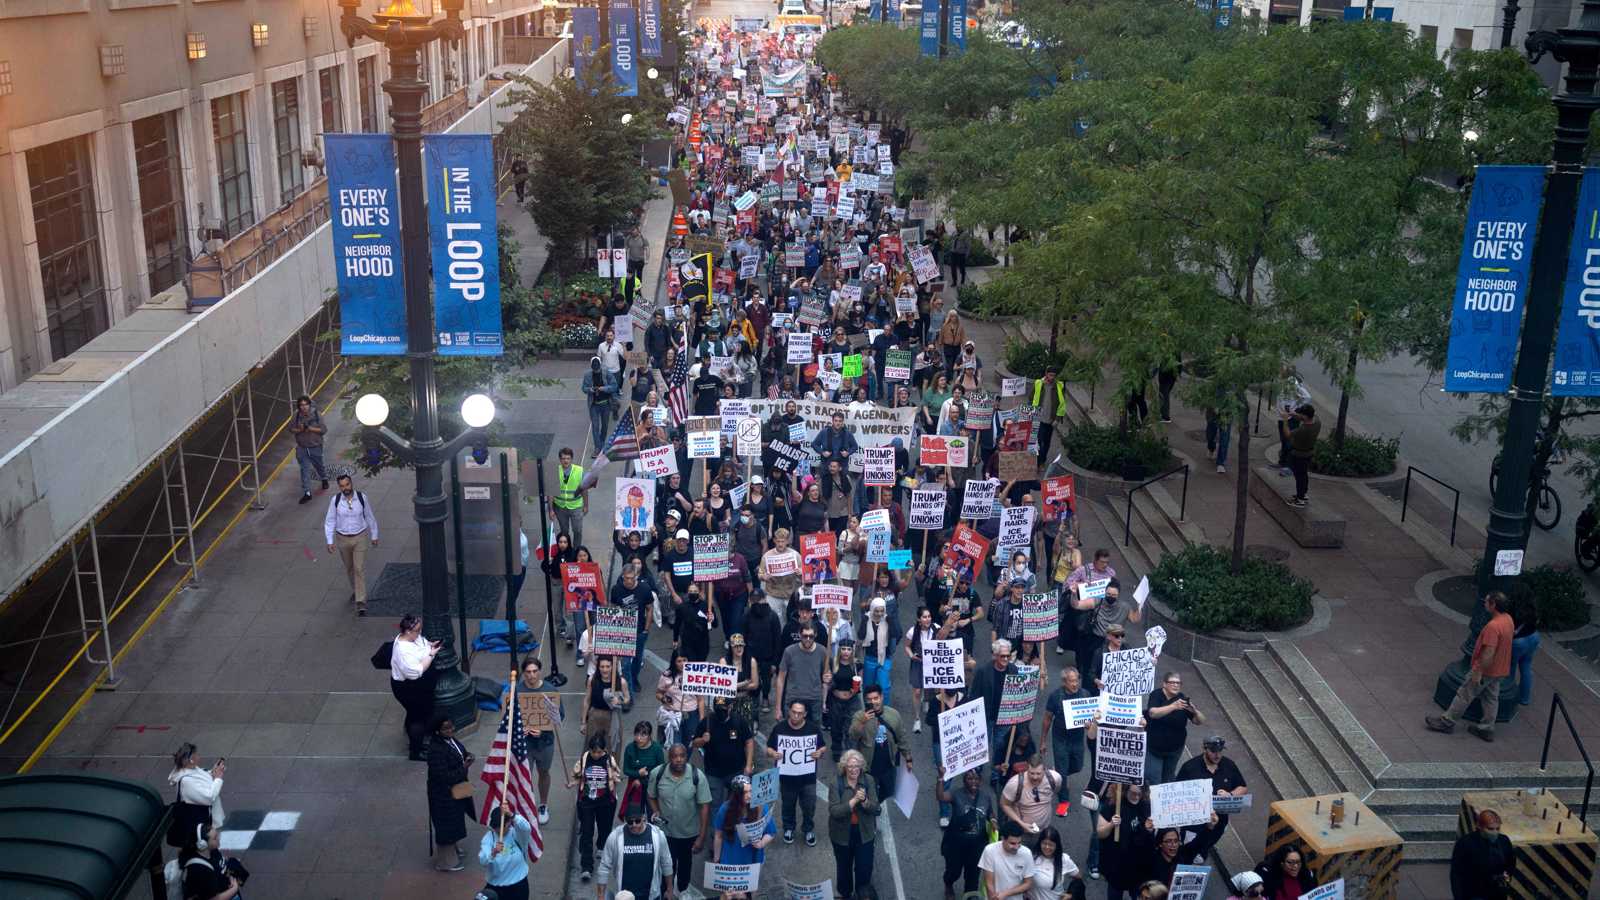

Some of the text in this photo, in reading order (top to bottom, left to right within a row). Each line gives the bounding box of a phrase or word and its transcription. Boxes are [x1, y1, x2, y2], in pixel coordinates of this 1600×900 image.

[645, 14, 656, 39] LOOP
[953, 16, 962, 38] LOOP
[616, 38, 631, 70] LOOP
[340, 189, 387, 206] EVERY
[342, 208, 390, 226] ONE'S
[447, 168, 485, 300] IN THE LOOP
[1477, 221, 1527, 239] EVERY
[345, 246, 391, 256] NEIGHBOR
[1473, 240, 1524, 260] ONE'S
[346, 258, 393, 277] HOOD
[1468, 278, 1517, 292] NEIGHBOR
[1465, 292, 1515, 313] HOOD
[350, 334, 400, 344] LoopChicago.com
[1454, 370, 1504, 380] LoopChicago.com
[855, 410, 899, 421] AGENDA!
[640, 448, 669, 459] TRUMP
[769, 439, 808, 460] ABOLISH
[866, 450, 893, 458] TRUMP:
[774, 456, 790, 471] ICE
[968, 482, 995, 491] TRUMP:
[914, 492, 944, 500] TRUMP:
[963, 505, 991, 514] UNIONS!
[912, 515, 942, 524] UNIONS!
[599, 607, 620, 616] STOP
[1105, 649, 1145, 664] CHICAGO
[685, 664, 736, 676] SUPPORT
[933, 667, 954, 675] ICE
[1104, 662, 1133, 673] AGAINST
[688, 674, 731, 687] DEFEND
[925, 675, 963, 684] FUERA
[1007, 675, 1027, 683] STOP
[683, 685, 736, 696] CONSTITUTION
[1106, 716, 1135, 725] CHICAGO
[1116, 731, 1144, 740] PEOPLE
[778, 737, 817, 748] ABOLISH
[1100, 737, 1143, 750] UNITED
[781, 748, 815, 765] ICE
[1099, 756, 1142, 768] IMMIGRANT
[1098, 763, 1141, 776] FAMILIES!
[1308, 888, 1324, 899] HANDS
